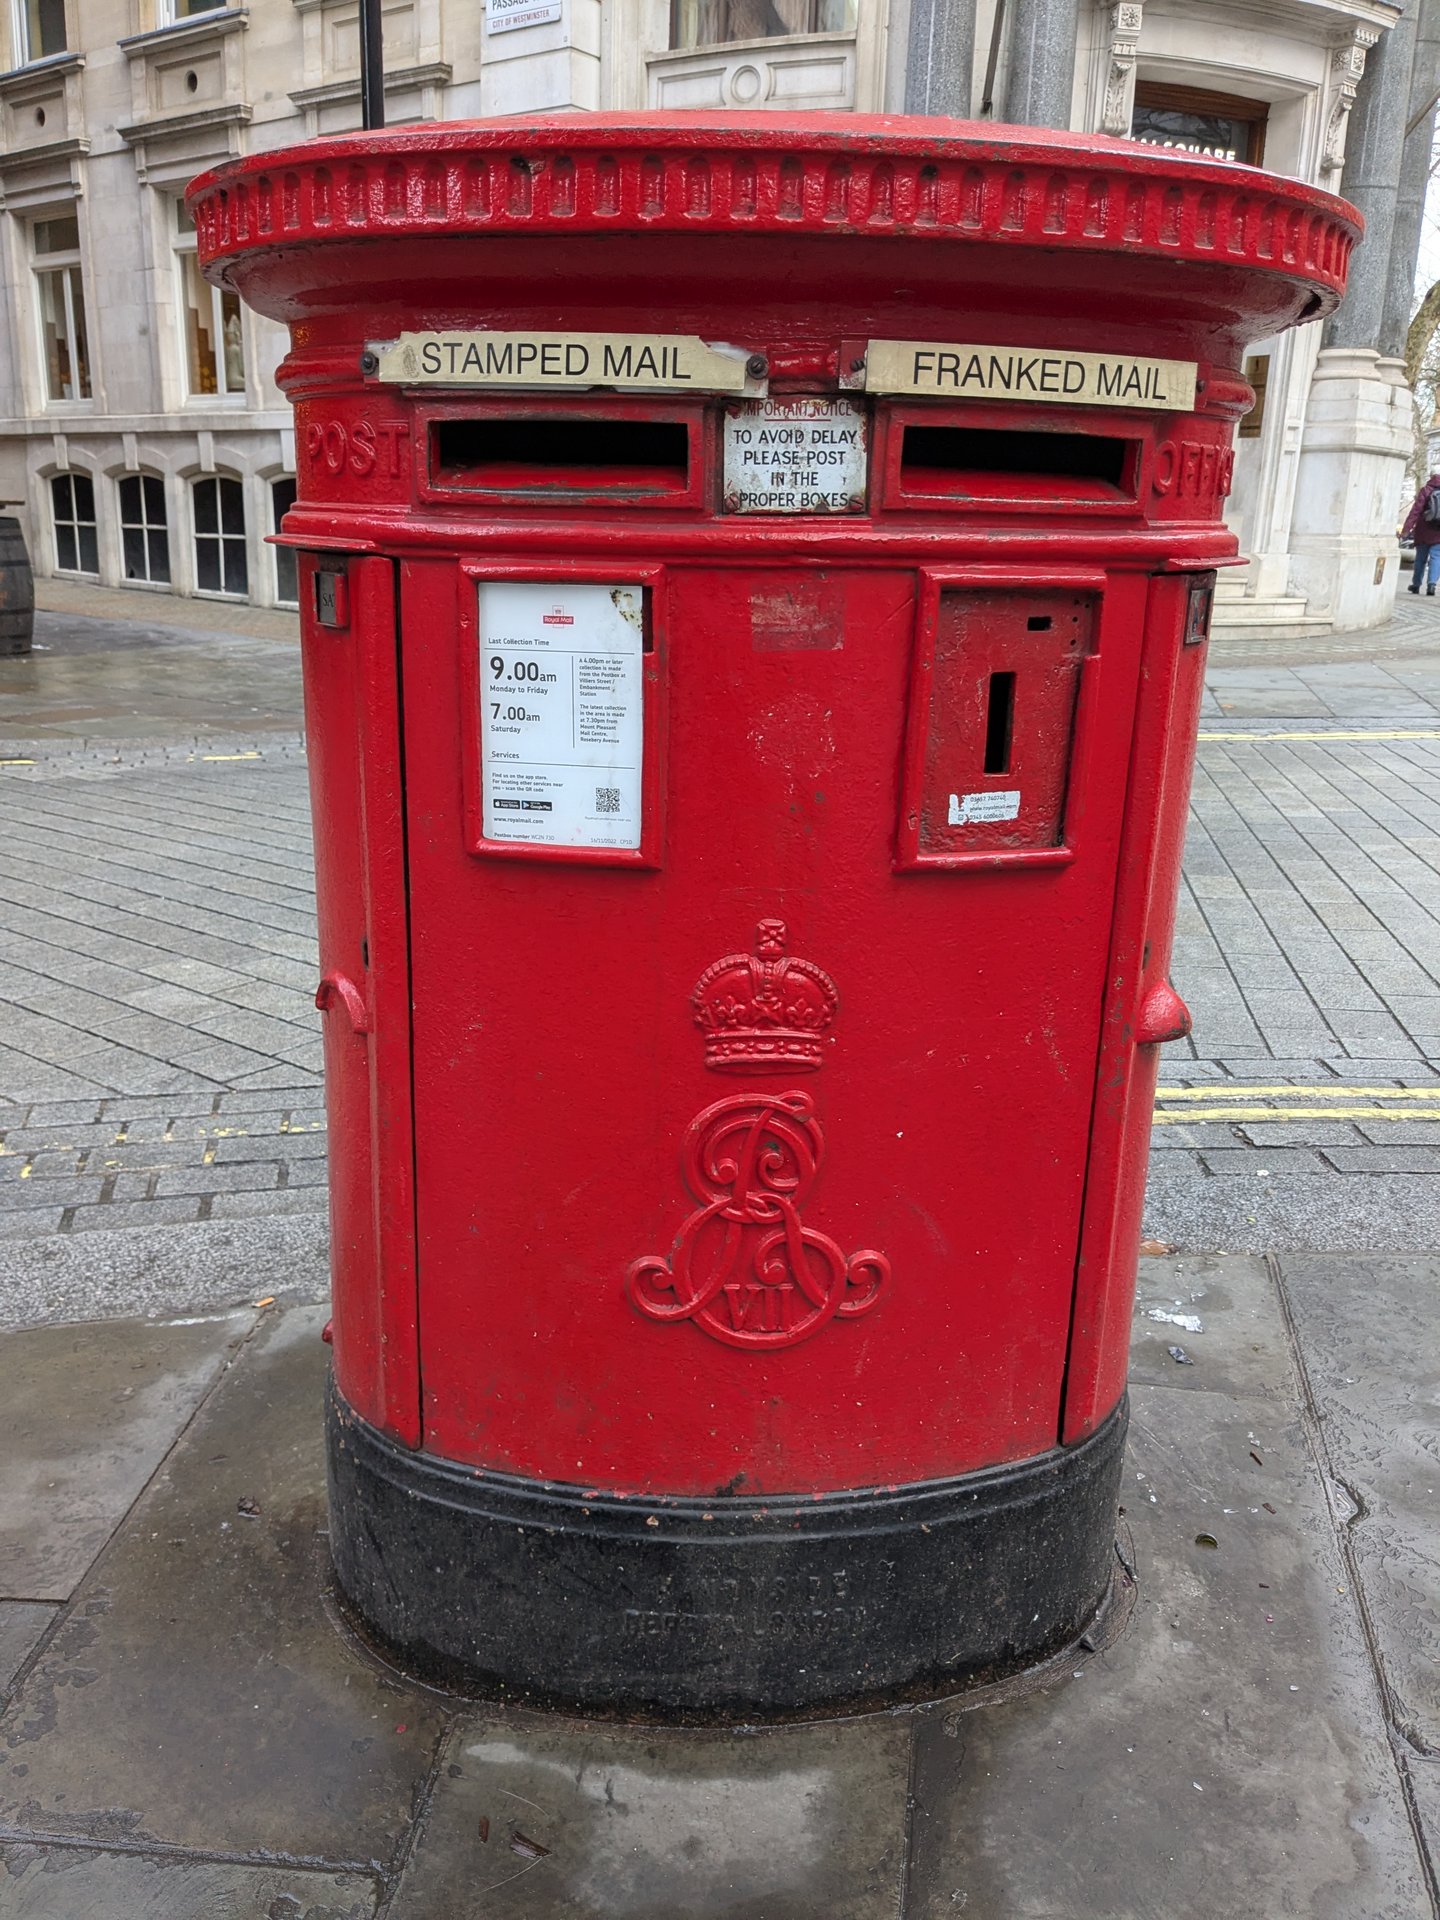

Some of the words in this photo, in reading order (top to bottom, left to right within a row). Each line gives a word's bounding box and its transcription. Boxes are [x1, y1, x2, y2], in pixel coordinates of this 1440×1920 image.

[492, 19, 504, 28] CITY
[513, 10, 550, 24] WESTMINSTER
[422, 342, 590, 375] STAMPED
[603, 344, 692, 379] MAIL
[913, 351, 1086, 394] FRANKED
[1096, 363, 1166, 401] MAIL
[733, 429, 752, 444] TO
[758, 429, 804, 444] AVOID
[811, 429, 858, 445] DELAY
[306, 419, 411, 479] POST
[744, 450, 800, 466] PLEASE
[806, 450, 846, 466] POST
[771, 471, 785, 486] IN
[791, 471, 820, 486] THE
[741, 492, 796, 507] PROPER
[801, 492, 848, 507] BOXES
[323, 593, 335, 608] SA
[490, 656, 557, 682] 9.00am
[490, 685, 516, 694] Monday
[527, 686, 548, 696] Friday
[490, 703, 540, 722] 7.00am
[490, 725, 522, 734] Saturday
[722, 1284, 794, 1332] VII
